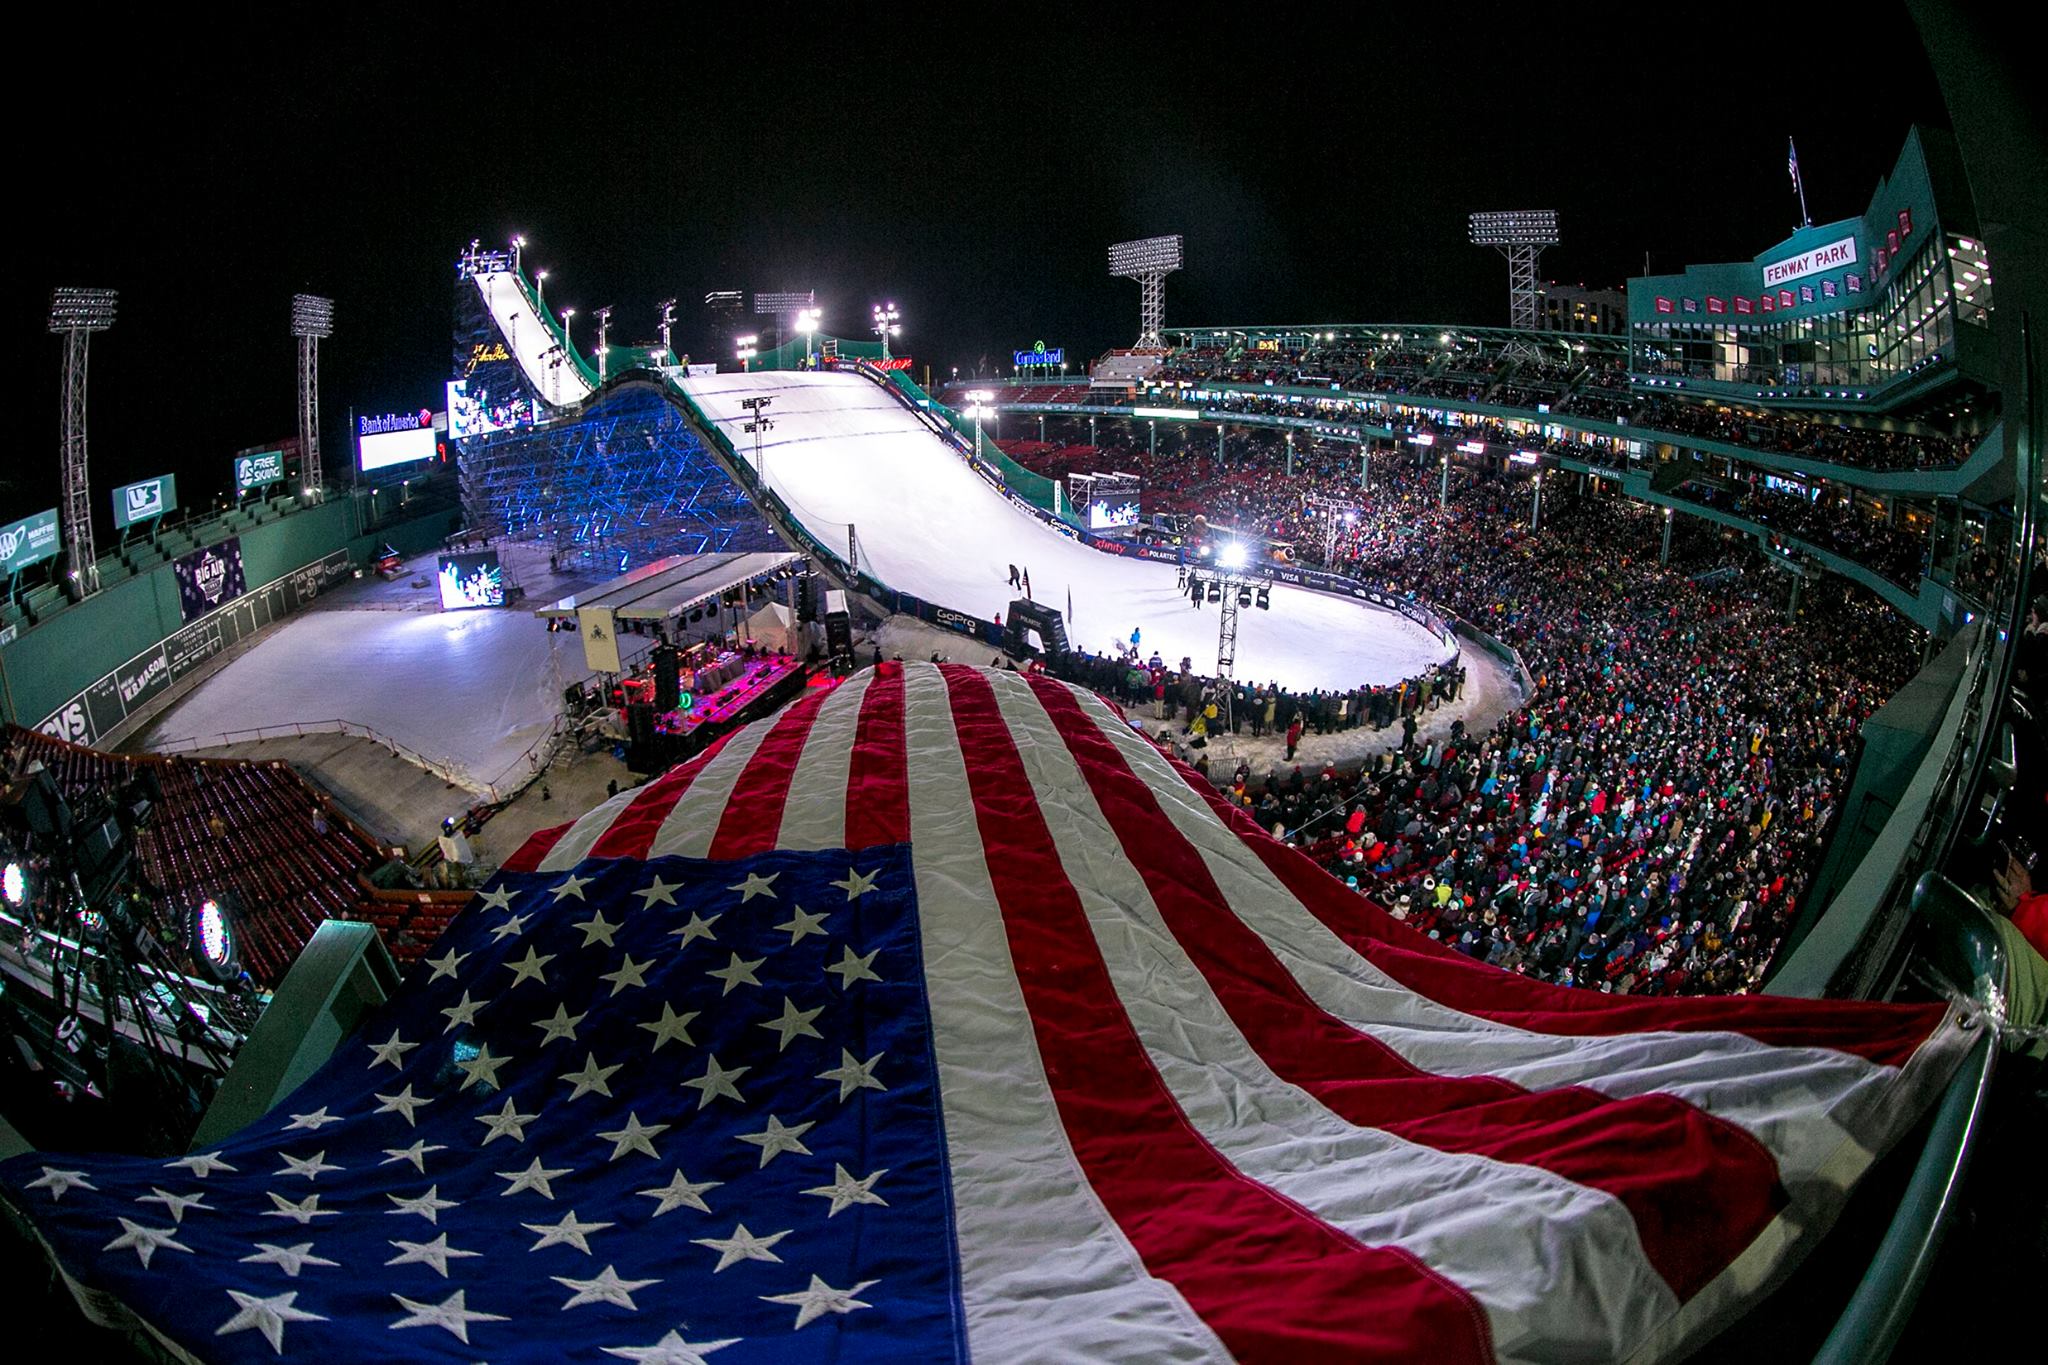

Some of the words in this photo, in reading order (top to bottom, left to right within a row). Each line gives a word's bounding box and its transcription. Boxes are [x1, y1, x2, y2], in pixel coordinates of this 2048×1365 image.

[1767, 256, 1810, 283] FENWAY
[1814, 243, 1850, 268] PARK
[360, 415, 382, 435] Bank
[382, 413, 392, 432] of
[391, 412, 420, 431] America
[253, 455, 276, 470] FREE
[1095, 538, 1126, 554] xfinity
[1149, 550, 1178, 561] POLARTEC
[194, 564, 211, 587] BIG
[210, 558, 226, 577] AIR
[1280, 571, 1301, 583] VISA
[936, 608, 976, 628] GoPro
[41, 702, 86, 742] CVS
